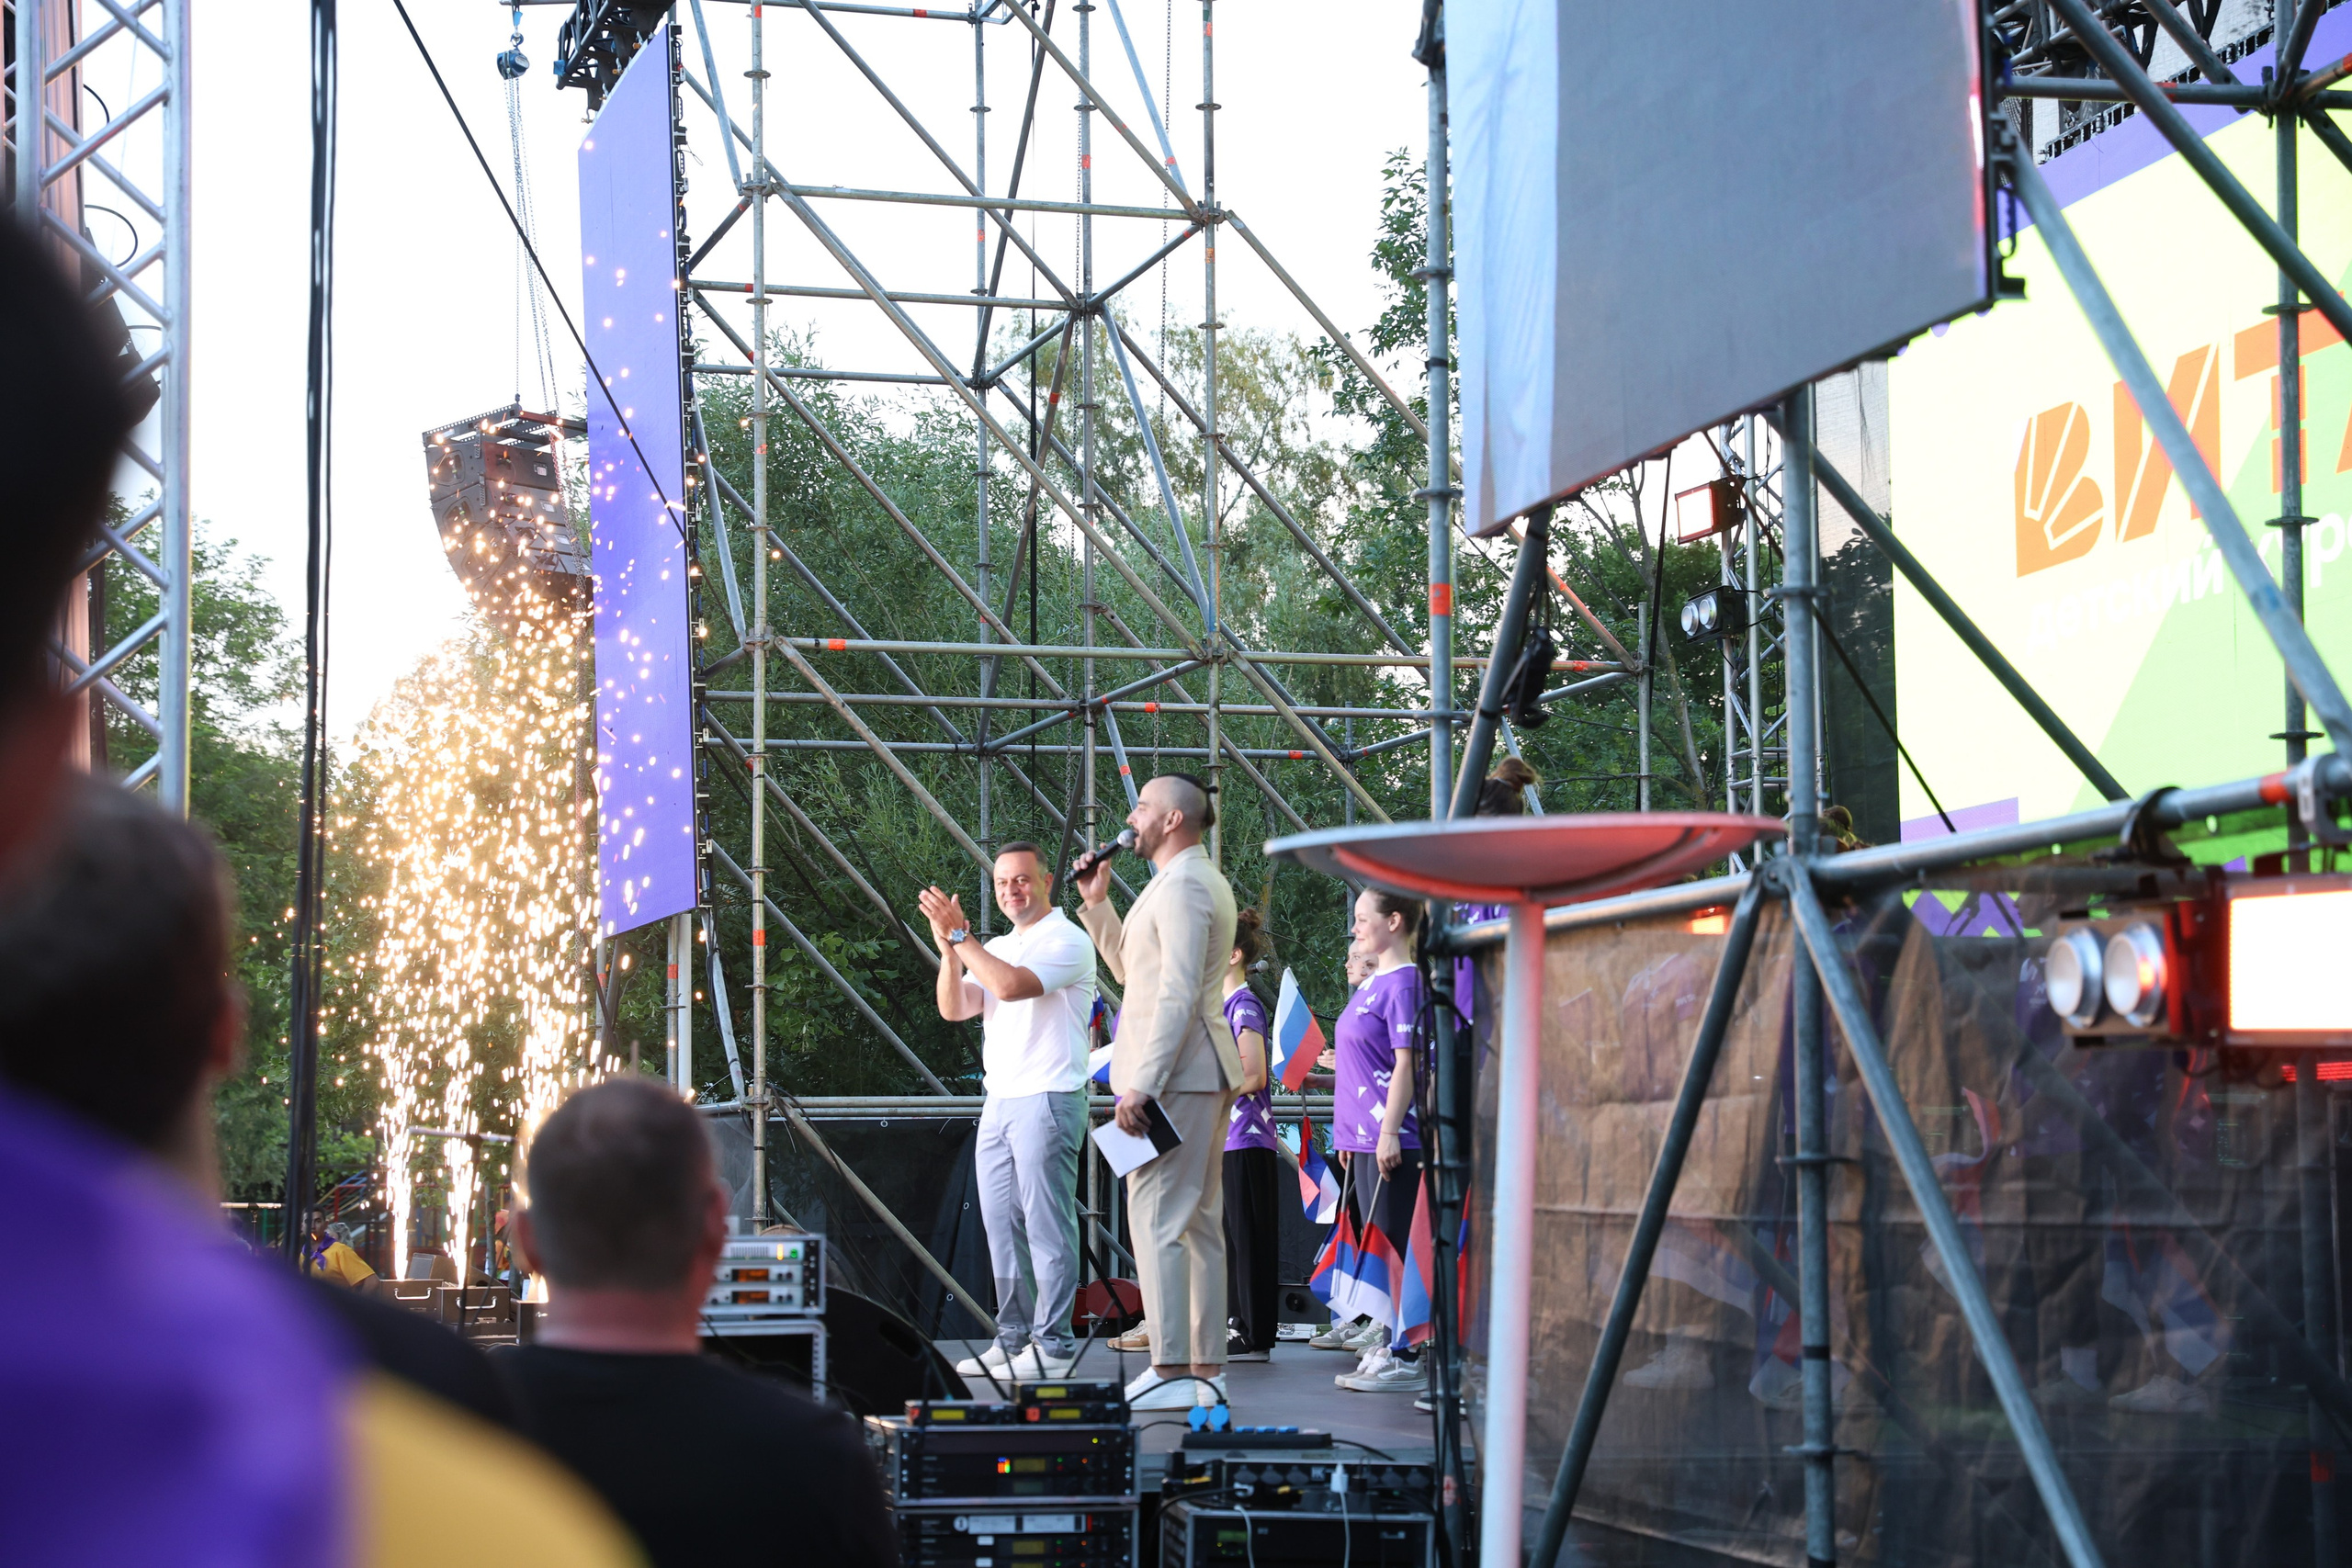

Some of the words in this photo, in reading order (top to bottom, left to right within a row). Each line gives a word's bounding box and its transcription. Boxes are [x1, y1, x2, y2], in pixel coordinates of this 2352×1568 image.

[2014, 292, 2351, 579] ВИТ
[2025, 531, 2224, 659] детский
[1396, 1023, 1422, 1035] ВИА
